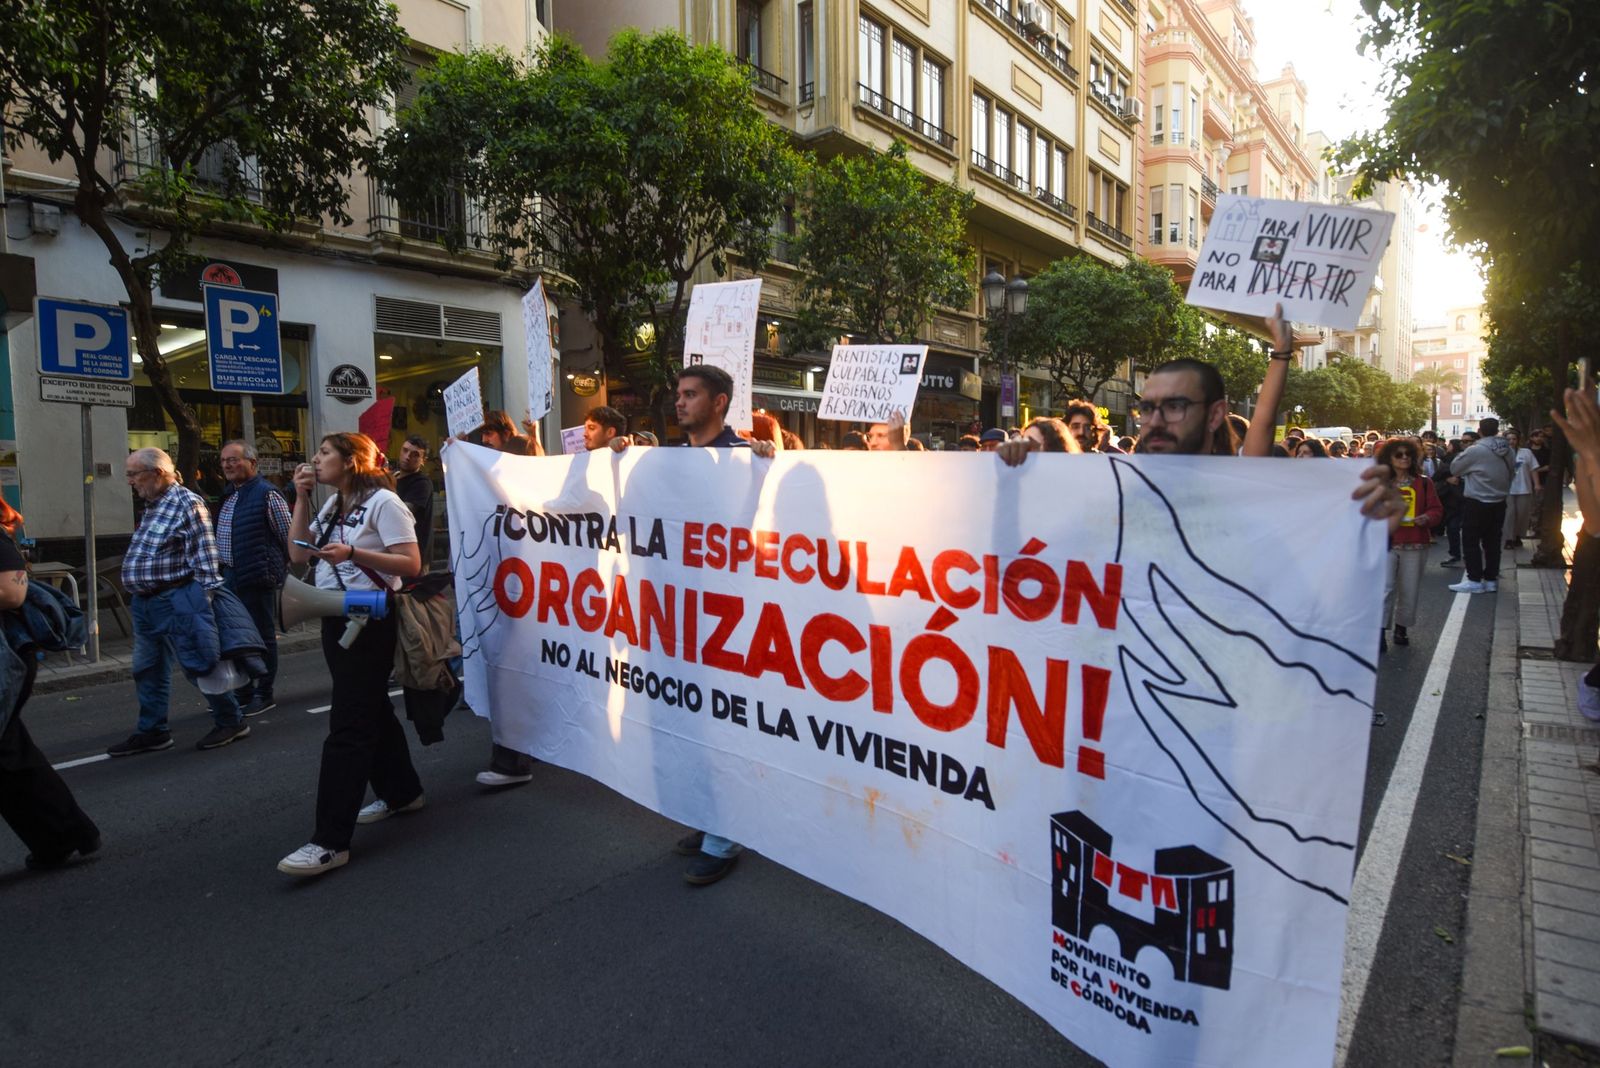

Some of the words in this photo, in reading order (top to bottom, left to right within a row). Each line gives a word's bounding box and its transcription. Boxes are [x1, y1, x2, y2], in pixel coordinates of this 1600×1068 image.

[1261, 217, 1300, 238] PARA
[1306, 213, 1373, 254] VIVIR
[1207, 250, 1241, 267] NO
[1199, 270, 1237, 293] PARA
[1247, 260, 1357, 307] INVERTIR
[219, 299, 260, 349] P
[56, 309, 112, 368] P
[82, 352, 97, 360] REAL
[99, 361, 123, 369] AMISTAD
[243, 356, 277, 364] DESCARGA
[836, 349, 900, 365] RENTISTAS
[42, 378, 78, 388] EXCEPTO
[97, 384, 131, 392] ESCOLAR
[216, 374, 236, 382] BUS
[237, 376, 278, 384] ESCOLAR
[832, 365, 903, 385] CULPABLES,
[326, 387, 372, 396] CALIFORNIA
[829, 382, 893, 400] GOBIERNOS
[780, 398, 804, 412] CAFÉ
[806, 401, 818, 413] LA
[629, 516, 668, 561] LA
[683, 521, 1124, 631] ESPECULACIÓN
[493, 557, 1112, 780] ORGANIZACIÓN!
[541, 638, 571, 668] NO
[575, 648, 600, 679] AL
[605, 656, 702, 713] NEGOCIO
[711, 688, 748, 728] DE
[757, 701, 800, 742] LA
[807, 715, 996, 811] VIVIENDA
[1053, 930, 1152, 990] MOVIMIENTO
[1052, 949, 1079, 976] POR
[1082, 968, 1103, 989] LA
[1109, 979, 1199, 1027] VIVIENDA
[1051, 966, 1068, 989] DE
[1070, 980, 1152, 1034] CÓRDOBA
